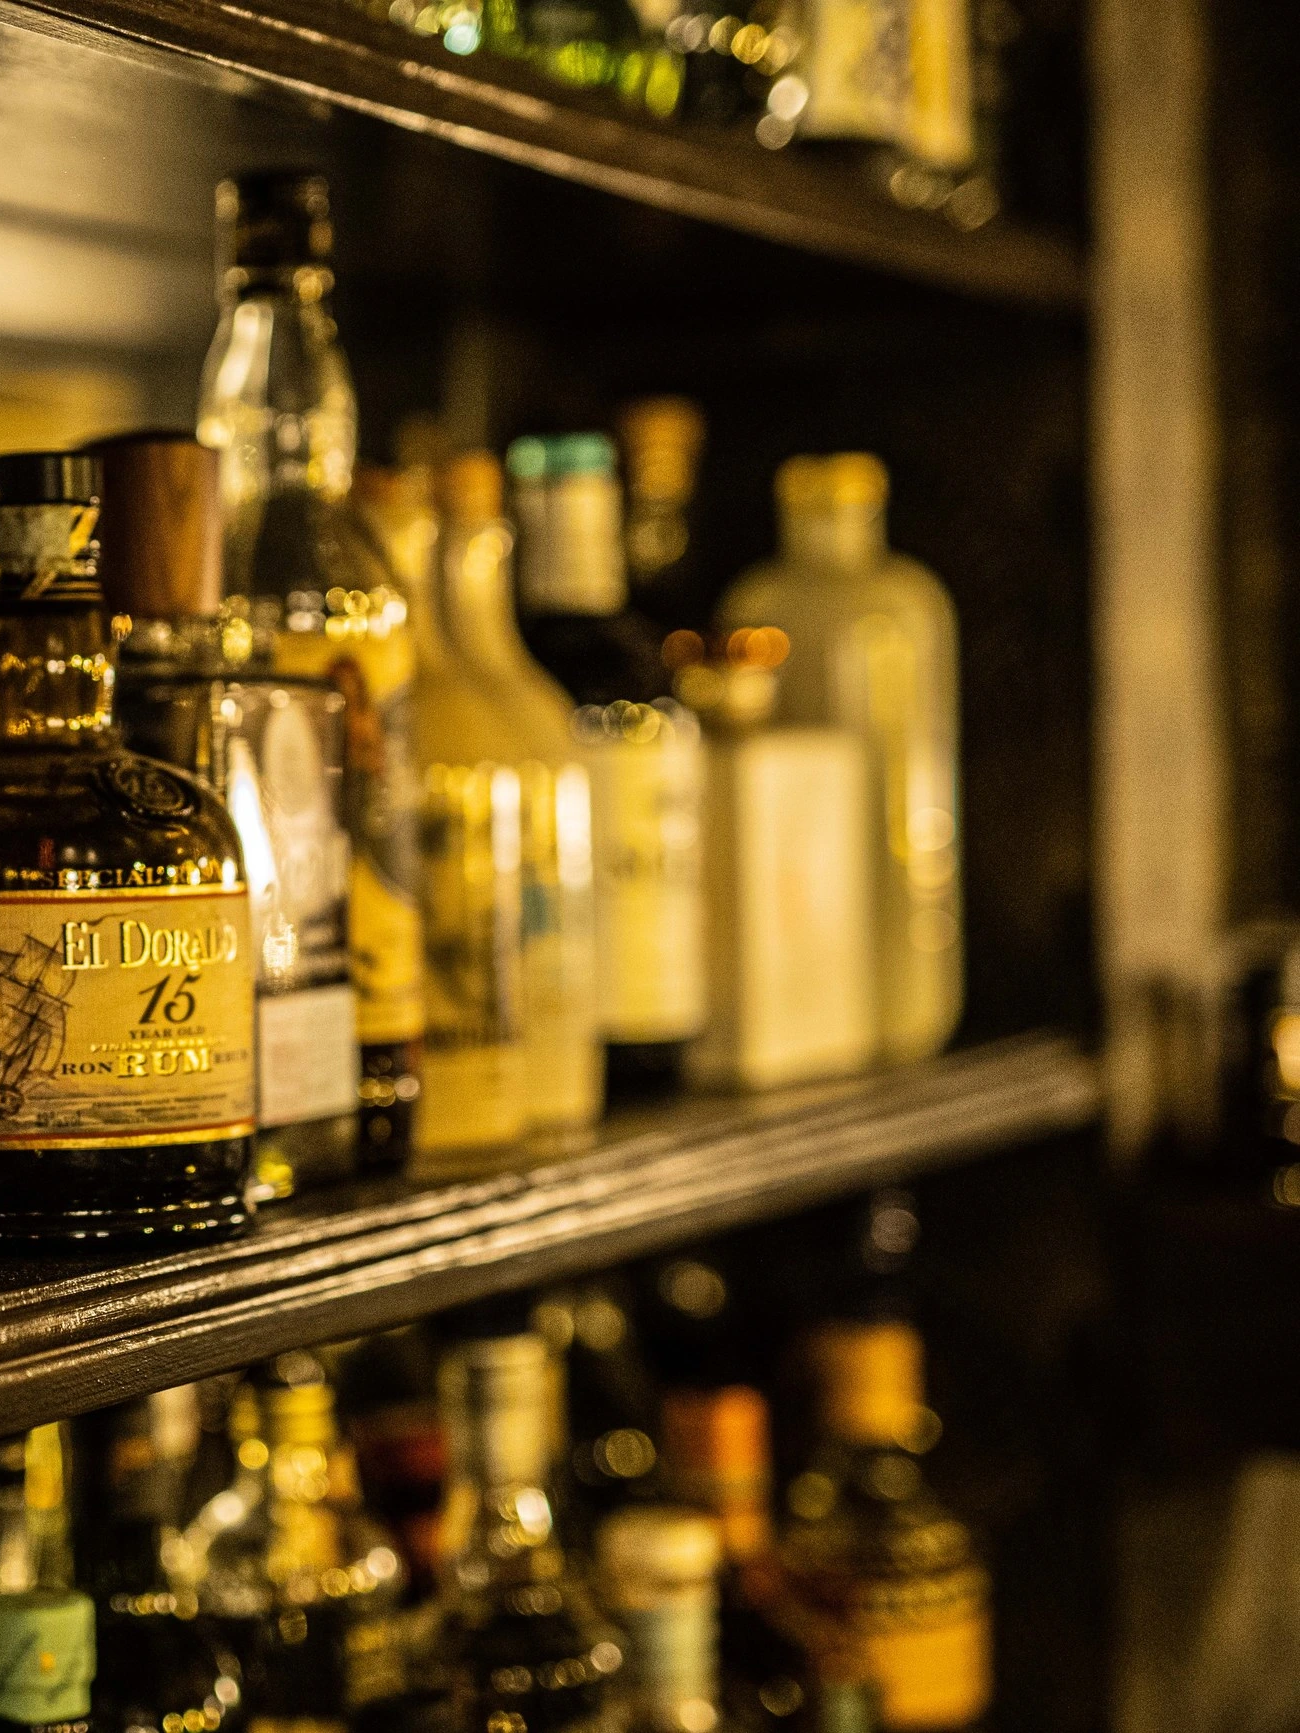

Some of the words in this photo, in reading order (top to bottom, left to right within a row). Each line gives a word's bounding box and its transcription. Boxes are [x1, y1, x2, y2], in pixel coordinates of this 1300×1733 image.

[137, 973, 202, 1024] 15
[129, 1027, 173, 1040] YEAR
[61, 1061, 114, 1075] RON
[117, 1047, 213, 1079] RUM
